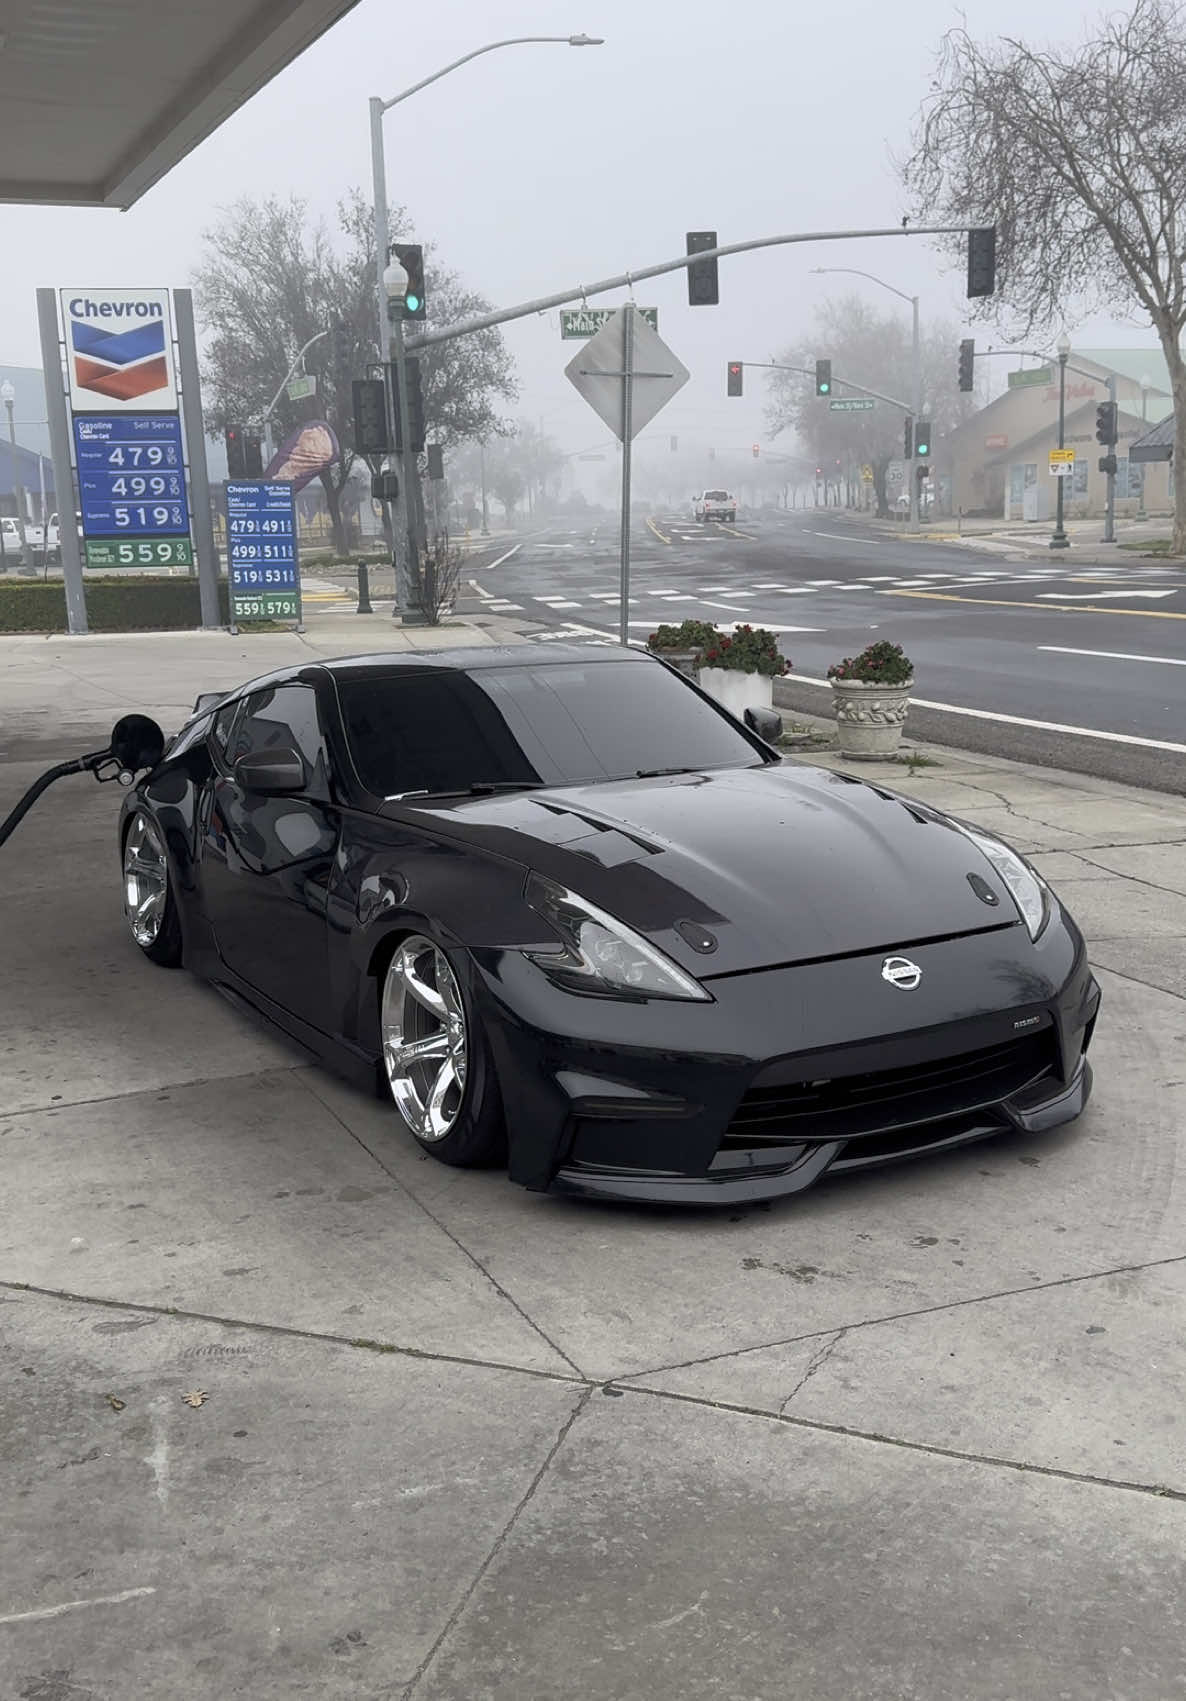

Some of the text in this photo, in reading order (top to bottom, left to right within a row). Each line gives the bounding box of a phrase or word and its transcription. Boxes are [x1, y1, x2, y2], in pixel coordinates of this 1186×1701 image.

[69, 298, 163, 317] Chevron
[573, 316, 594, 331] Main
[134, 421, 150, 429] Self
[152, 421, 175, 429] Serve
[108, 446, 163, 466] 479
[111, 477, 165, 496] 499
[227, 485, 259, 493] Chevron
[114, 507, 169, 526] 519
[230, 519, 255, 533] 479
[262, 519, 285, 533] 491
[119, 543, 172, 563] 559
[232, 545, 256, 558] 499
[264, 545, 286, 558] 511
[233, 570, 258, 583] 519
[265, 569, 288, 583] 531
[235, 602, 259, 615] 559
[267, 601, 291, 614] 579
